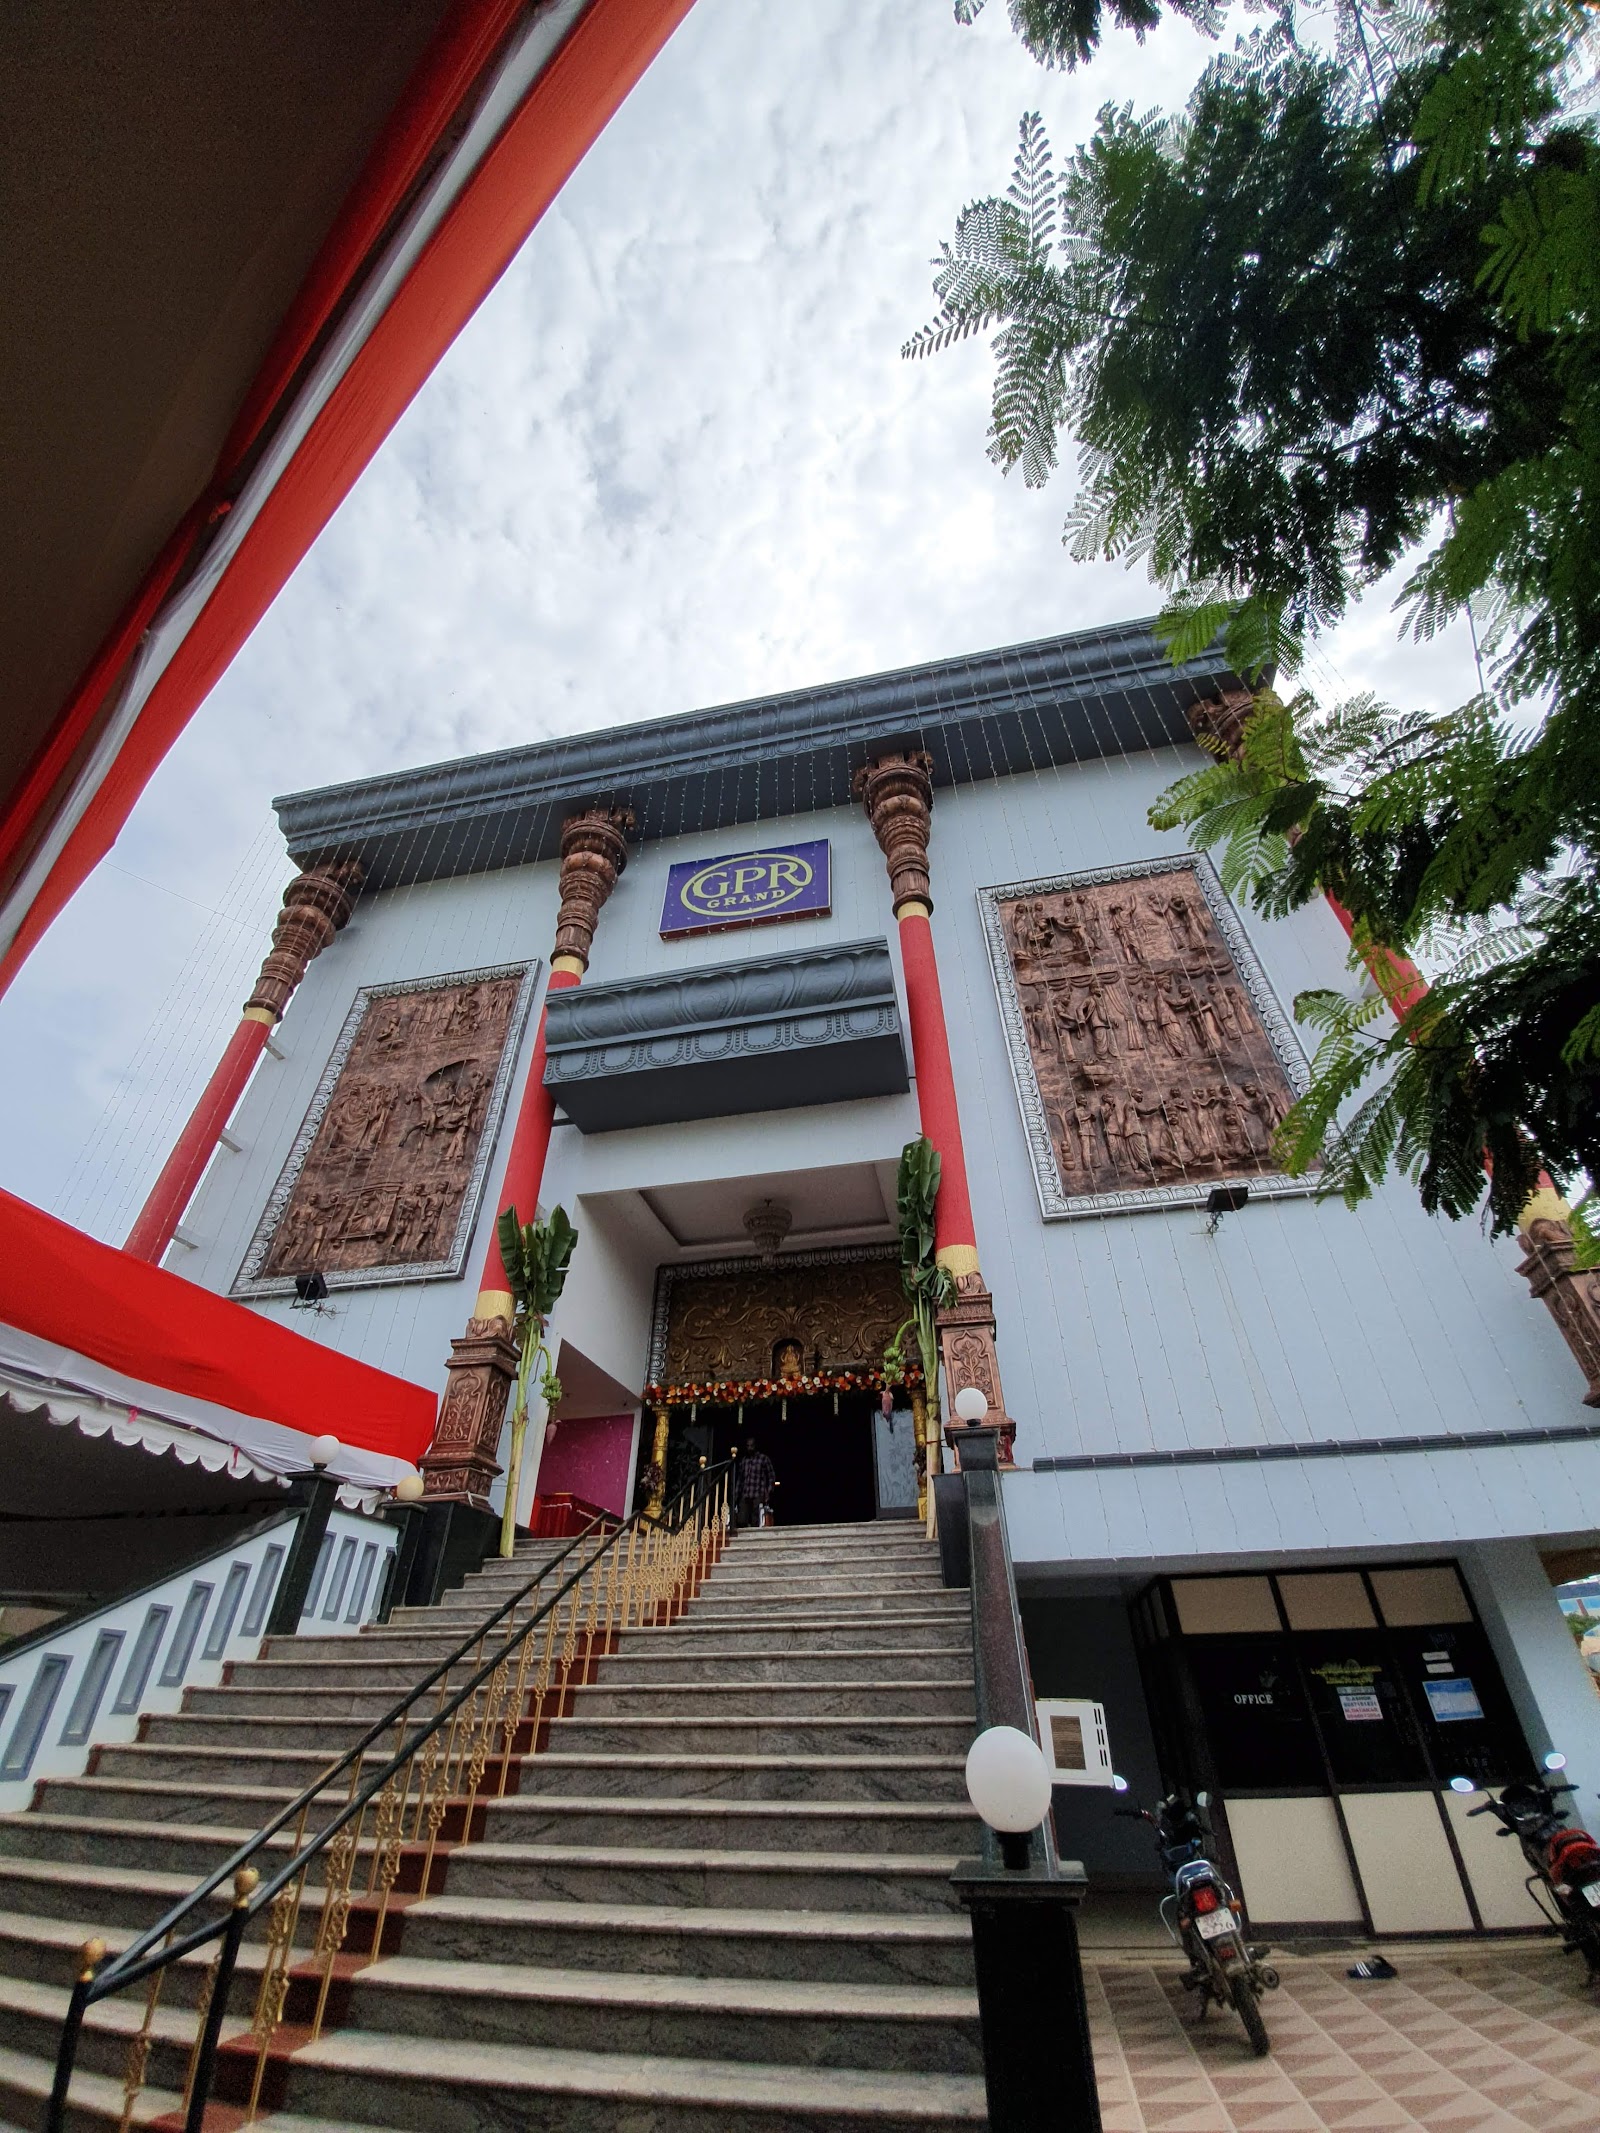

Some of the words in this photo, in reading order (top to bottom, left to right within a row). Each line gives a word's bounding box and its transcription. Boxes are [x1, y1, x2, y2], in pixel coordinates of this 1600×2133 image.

[692, 861, 804, 899] GPR
[706, 889, 786, 909] GRAND
[1233, 1693, 1274, 1705] OFFICE
